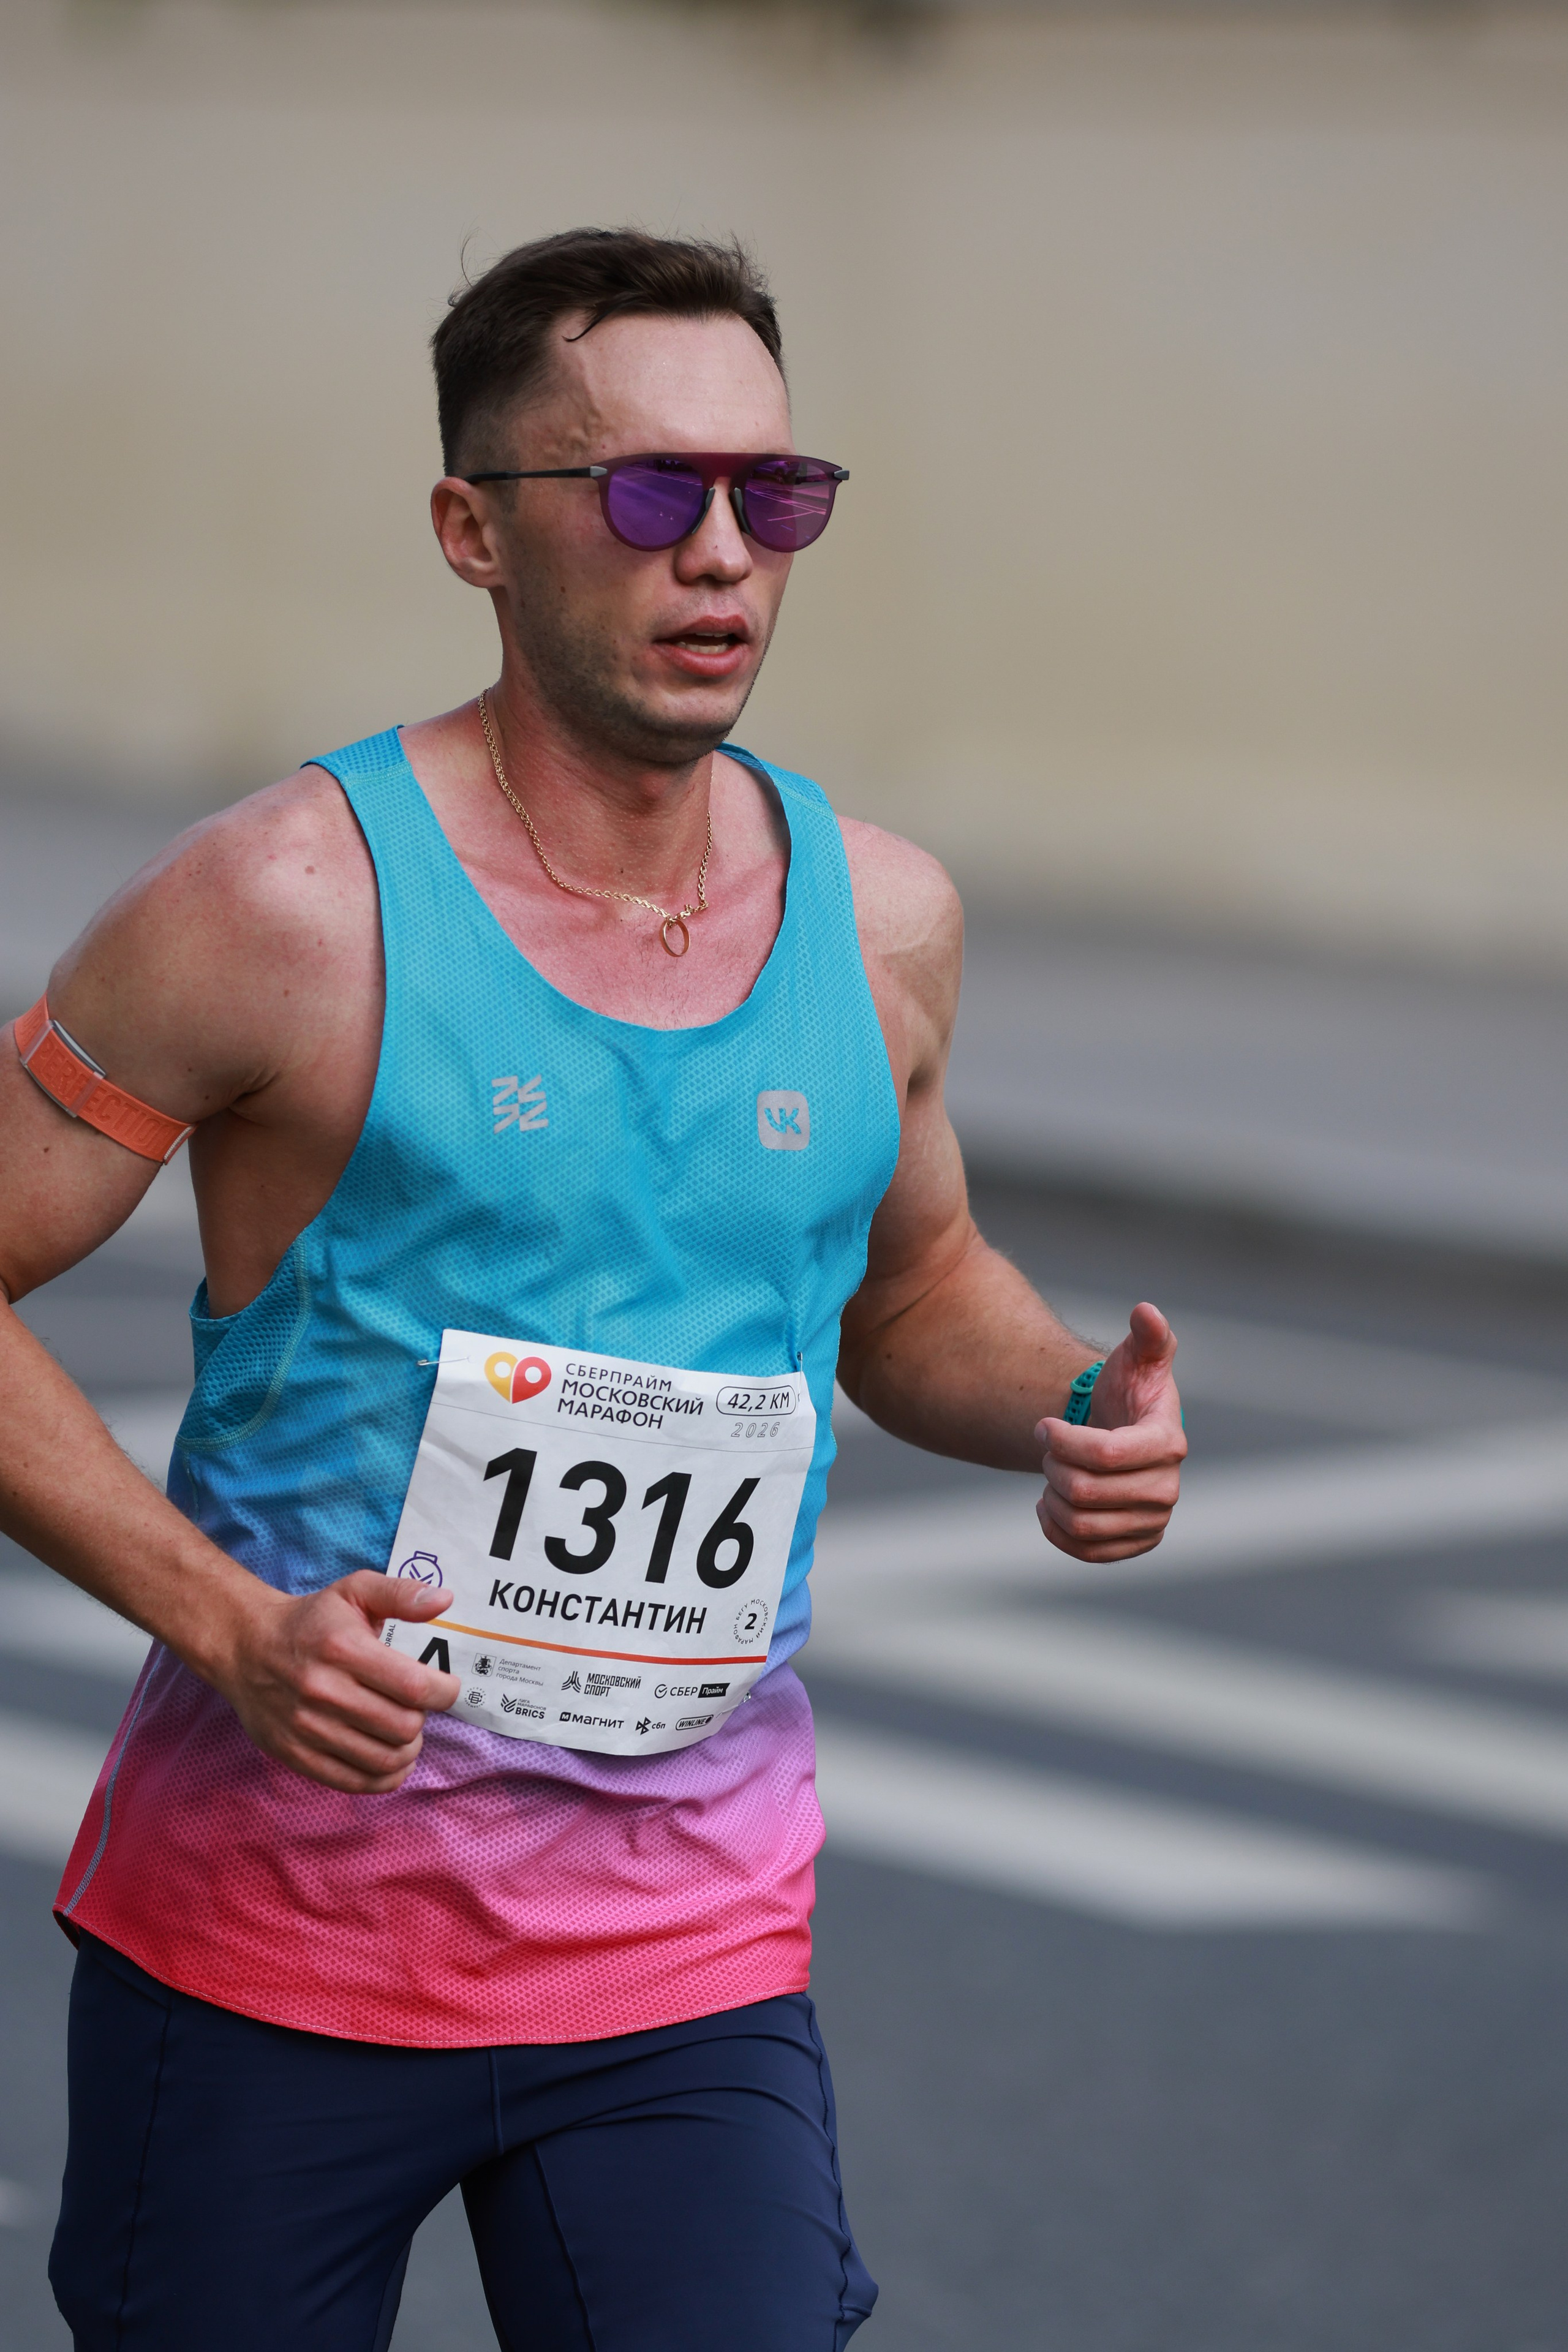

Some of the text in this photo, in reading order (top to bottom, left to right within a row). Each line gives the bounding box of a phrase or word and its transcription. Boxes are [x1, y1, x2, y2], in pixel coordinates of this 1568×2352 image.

[565, 1362, 672, 1392] СБЕРПРАЙМ
[561, 1378, 704, 1415] МОСКОВСКИЙ
[727, 1392, 790, 1410] 42,2 КМ
[557, 1398, 664, 1430] МАРАФОН
[731, 1422, 780, 1439] 2026
[483, 1447, 761, 1589] 1316
[488, 1579, 707, 1634] КОНСТАНТИН
[744, 1613, 757, 1630] 2
[385, 1624, 396, 1647] ORRAL
[498, 1666, 519, 1675] спорта
[499, 1659, 541, 1672] Департамент
[496, 1673, 544, 1686] города Москвы
[586, 1673, 642, 1689] МОСКОВСКИЙ
[584, 1684, 611, 1697] СПОРТ
[669, 1686, 724, 1697] СБЕР Прайм
[515, 1707, 545, 1719] BRICS
[517, 1702, 546, 1711] МАРАФОНОВ
[679, 1717, 707, 1728] WINLINE
